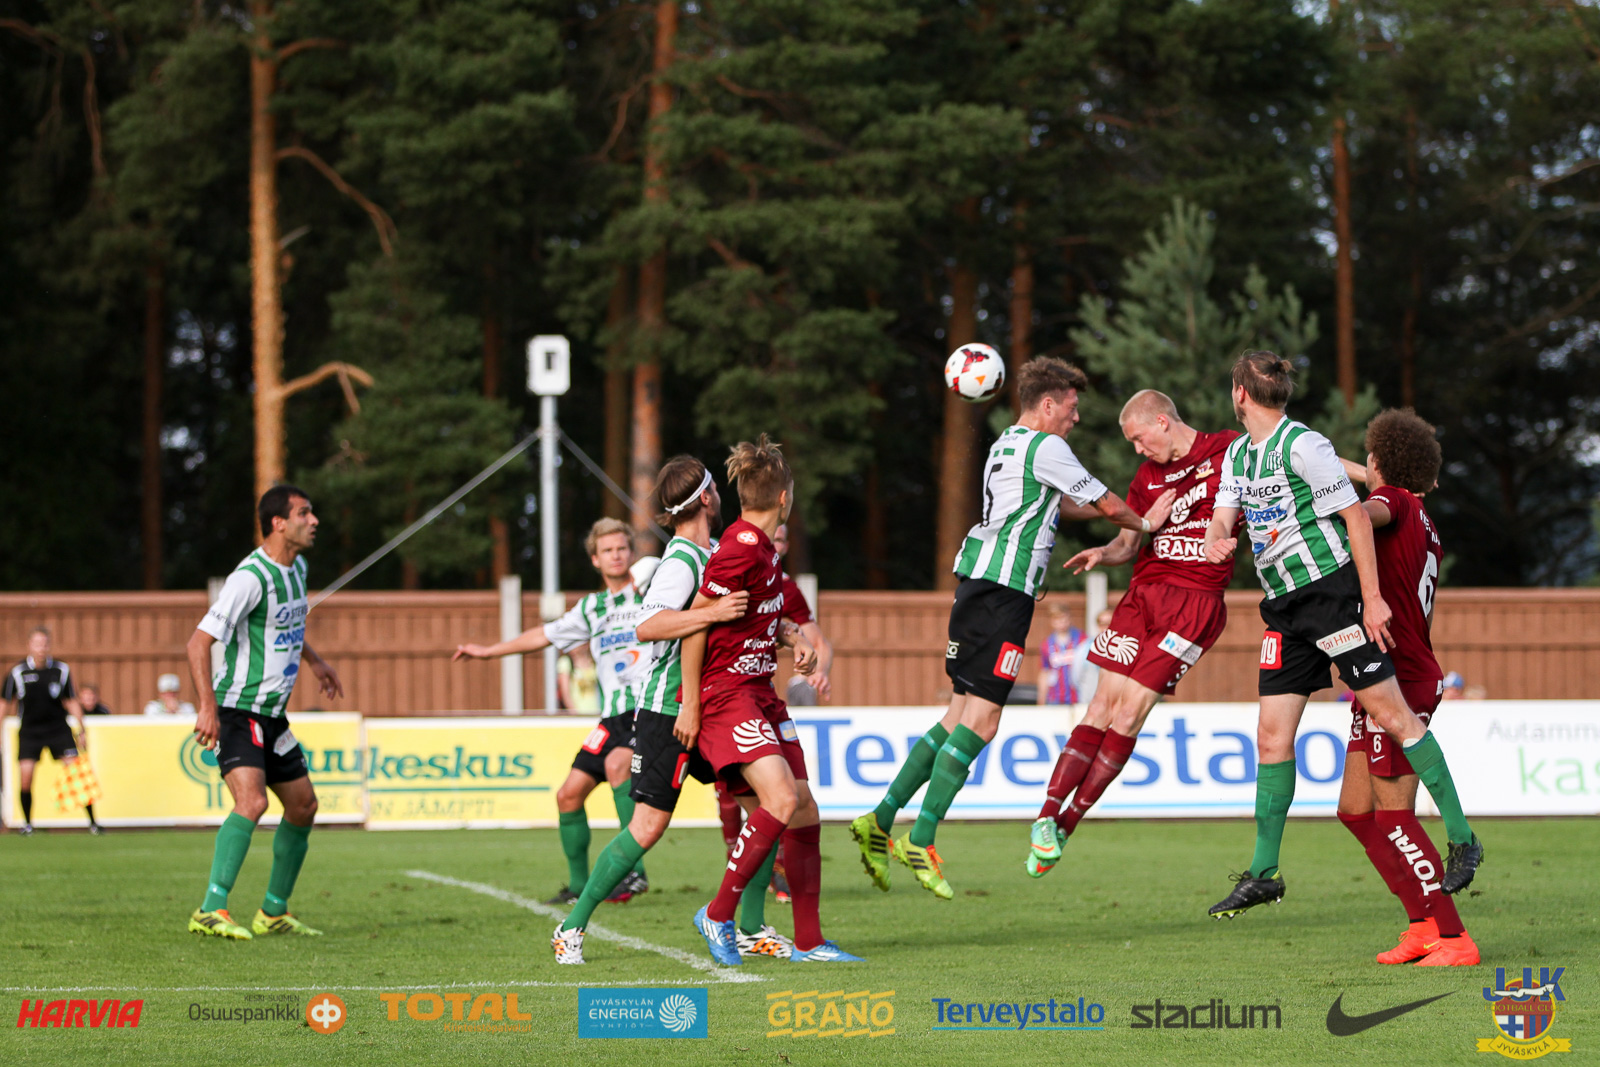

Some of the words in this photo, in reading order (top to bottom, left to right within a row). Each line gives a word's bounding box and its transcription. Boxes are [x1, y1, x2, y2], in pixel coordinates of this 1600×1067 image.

[1418, 551, 1438, 618] 6
[1335, 629, 1361, 646] Hing
[1353, 665, 1360, 678] 4
[1373, 734, 1382, 753] 6
[1388, 826, 1442, 896] TOTAL
